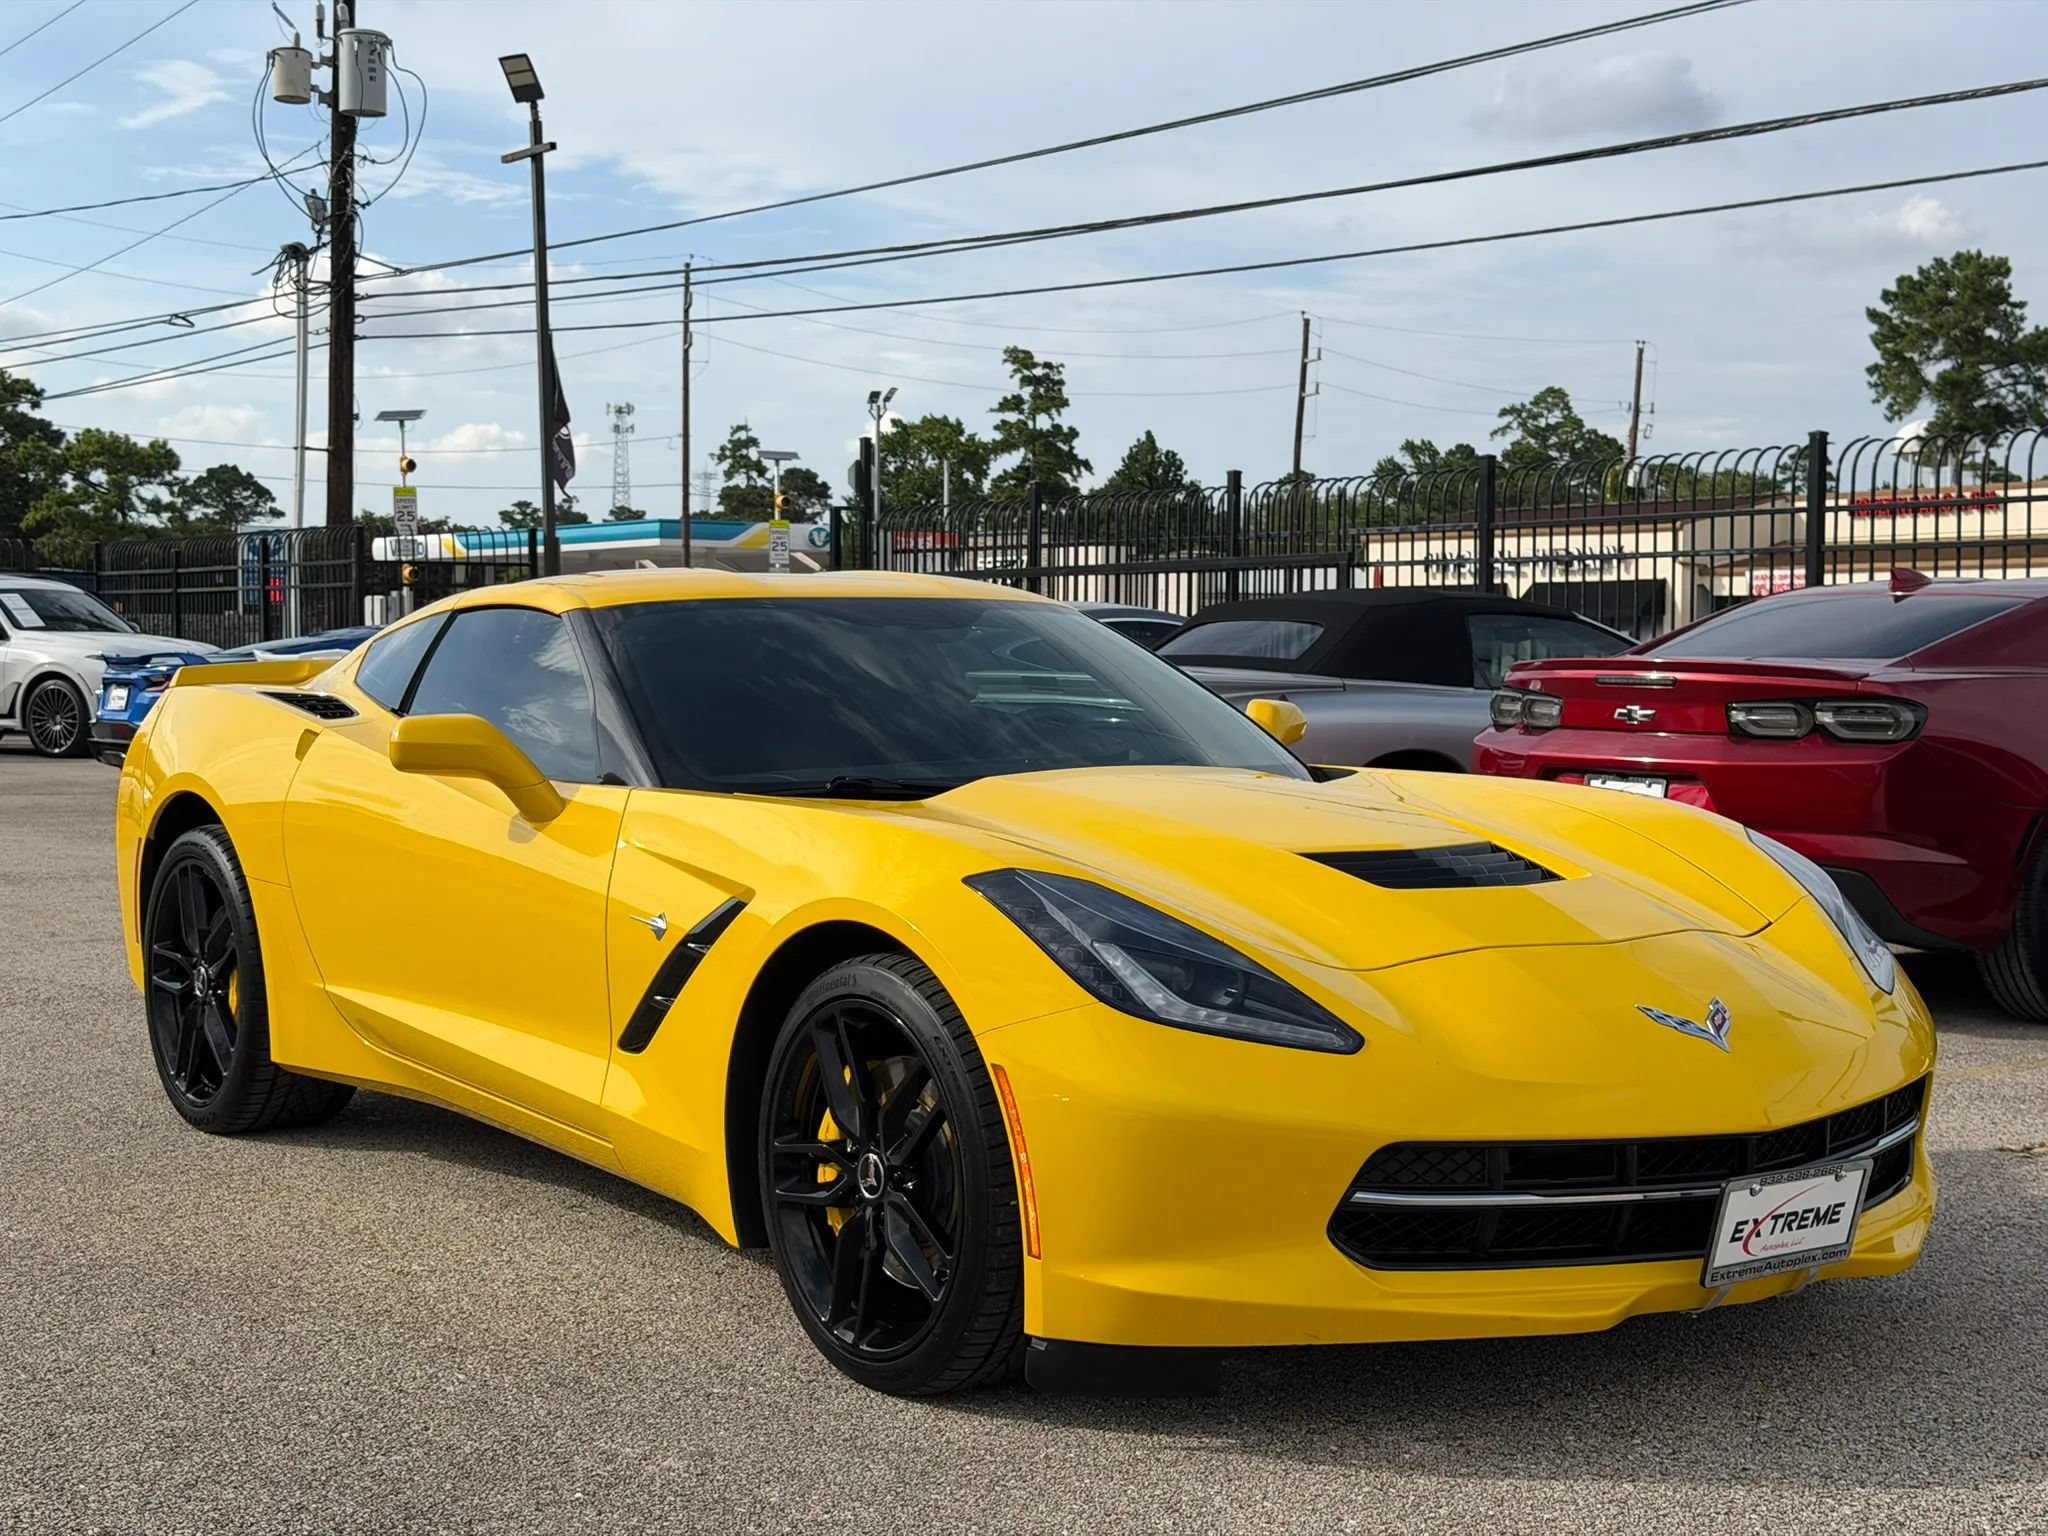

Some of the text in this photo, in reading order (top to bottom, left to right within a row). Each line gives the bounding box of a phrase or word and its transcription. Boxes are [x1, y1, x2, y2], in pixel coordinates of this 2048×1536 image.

[396, 510, 416, 522] 25
[771, 541, 788, 552] 25
[1728, 1201, 1847, 1244] EXTREME
[1710, 1249, 1847, 1283] ExtremeAutoplex.com
